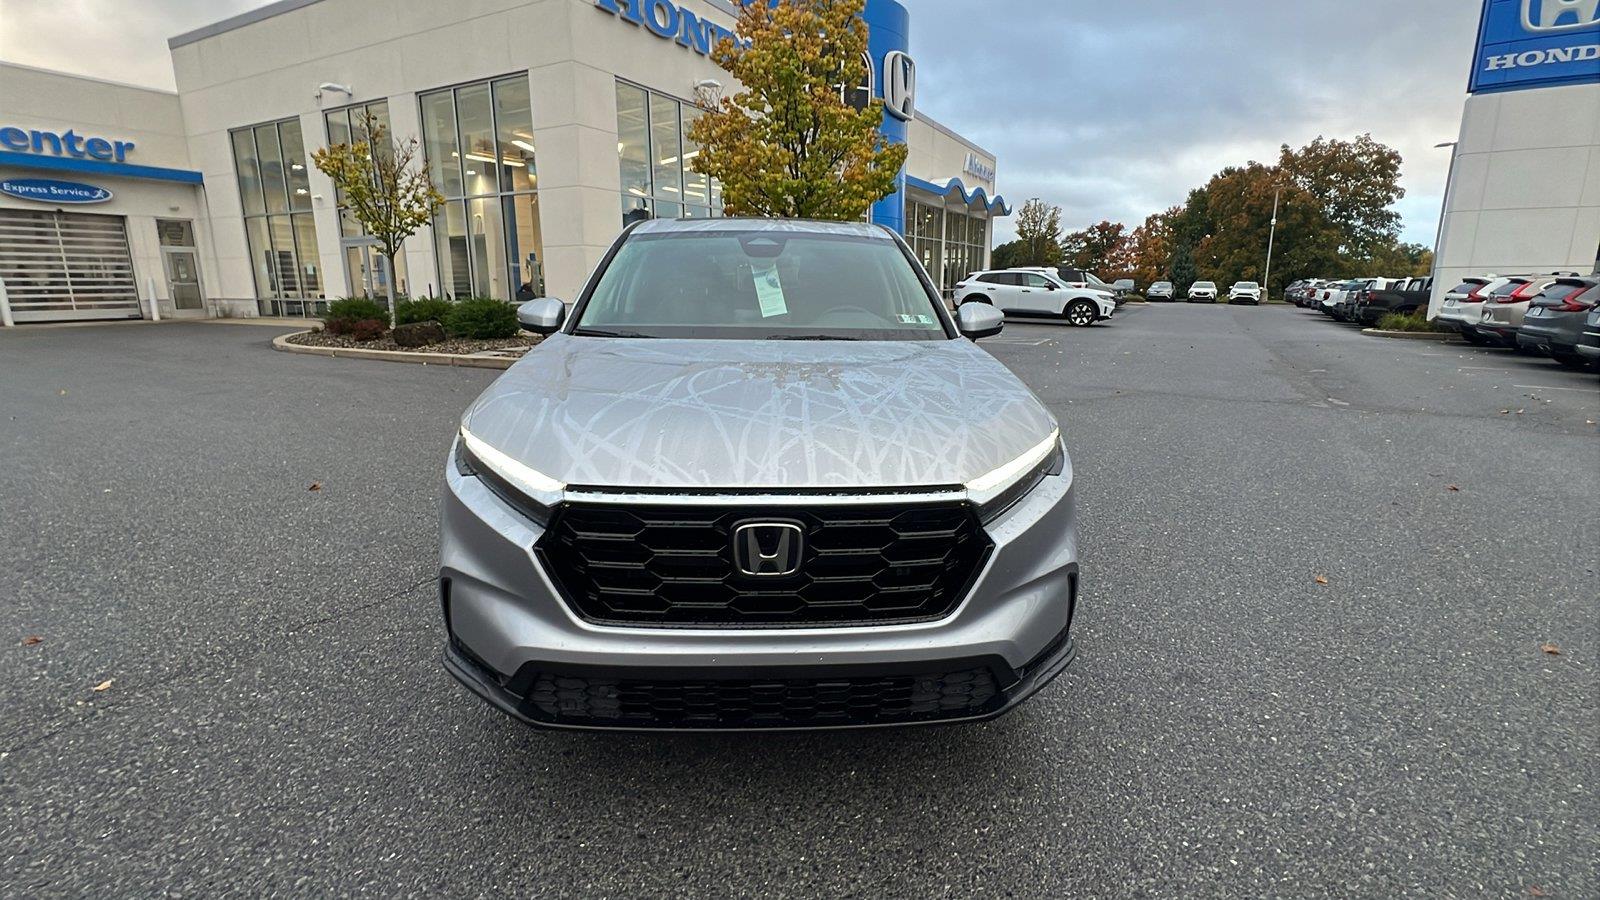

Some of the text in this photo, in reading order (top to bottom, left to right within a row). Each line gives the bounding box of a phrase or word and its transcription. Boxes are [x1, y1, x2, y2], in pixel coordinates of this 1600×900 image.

[0, 126, 135, 162] enter
[3, 182, 90, 197] Express Service
